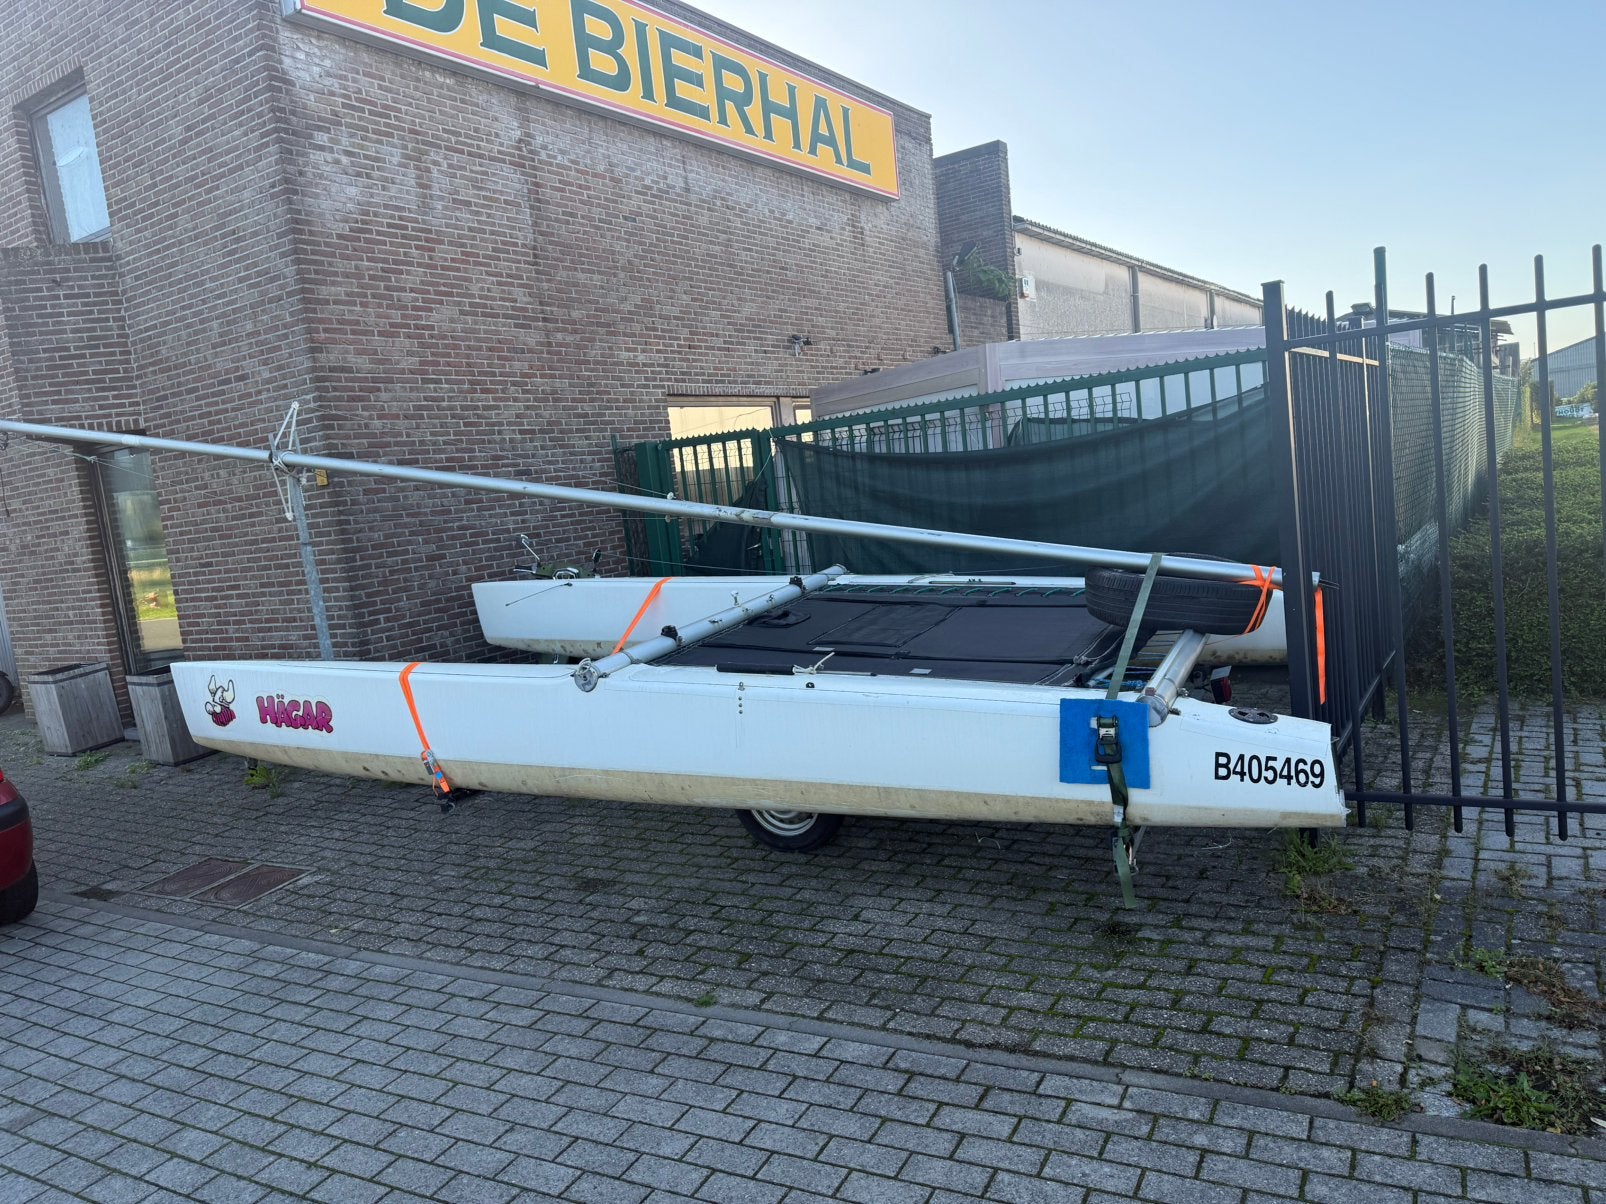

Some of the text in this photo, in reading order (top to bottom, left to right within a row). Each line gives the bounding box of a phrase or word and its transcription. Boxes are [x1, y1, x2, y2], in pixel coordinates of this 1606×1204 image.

[383, 0, 872, 176] E BIERHAL
[256, 693, 333, 733] HÄGAR
[1214, 751, 1325, 789] B405469
